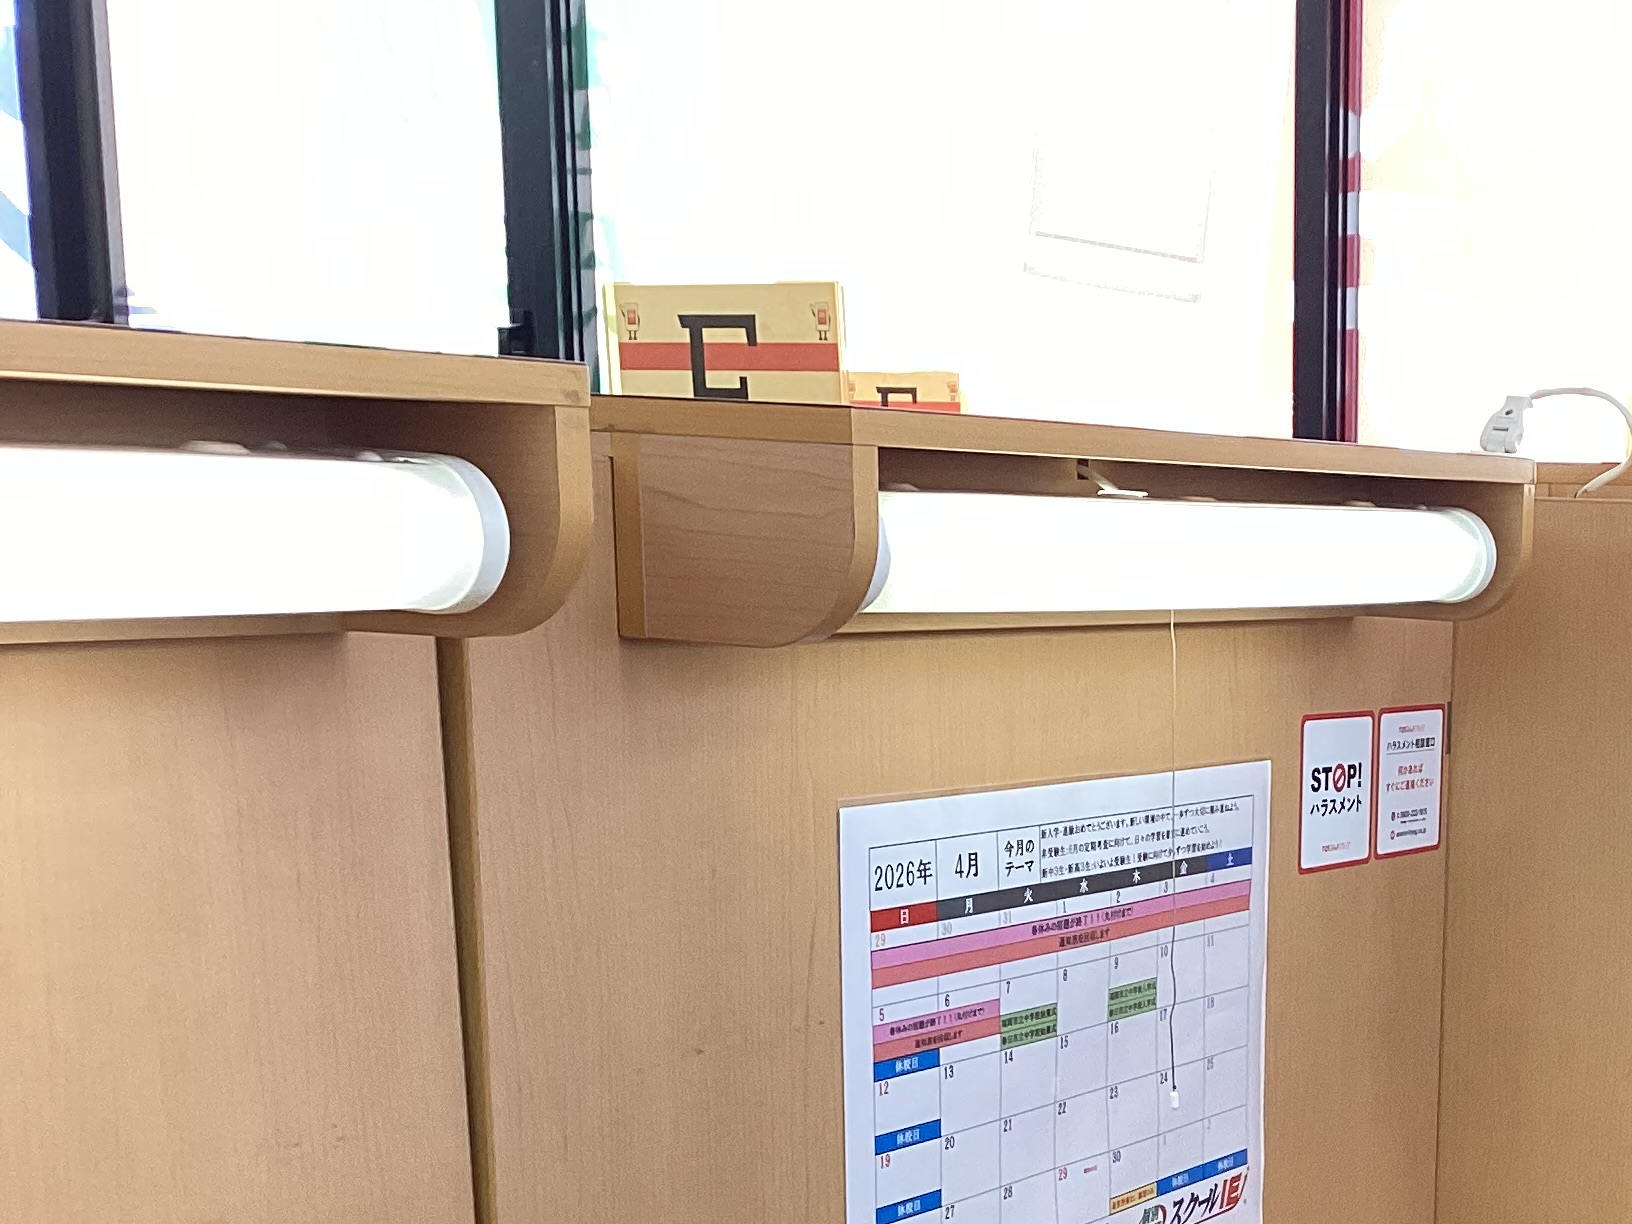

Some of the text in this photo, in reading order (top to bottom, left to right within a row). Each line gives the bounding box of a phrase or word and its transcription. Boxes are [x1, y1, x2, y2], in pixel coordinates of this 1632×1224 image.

[1310, 762, 1363, 793] STOP!
[1310, 794, 1362, 817] ハラスメント
[1003, 839, 1035, 858] 今月の
[874, 852, 979, 891] 2026年 4月
[1004, 860, 1035, 877] テーマ
[875, 872, 1215, 948] 29 30 31 1 2 3 4
[900, 908, 910, 925] 日
[964, 898, 974, 914] 月
[1023, 887, 1034, 903] 火
[879, 934, 1215, 1022] 5 6 7 8 9 10 11
[879, 996, 1215, 1096] 12 13 14 15 16 17 18
[880, 1057, 1214, 1169] 19 20 21 22 23 24 25
[945, 1205, 955, 1220] 27
[1003, 1186, 1013, 1200] 28
[1058, 1167, 1068, 1182] 29
[1112, 1150, 1121, 1164] 30
